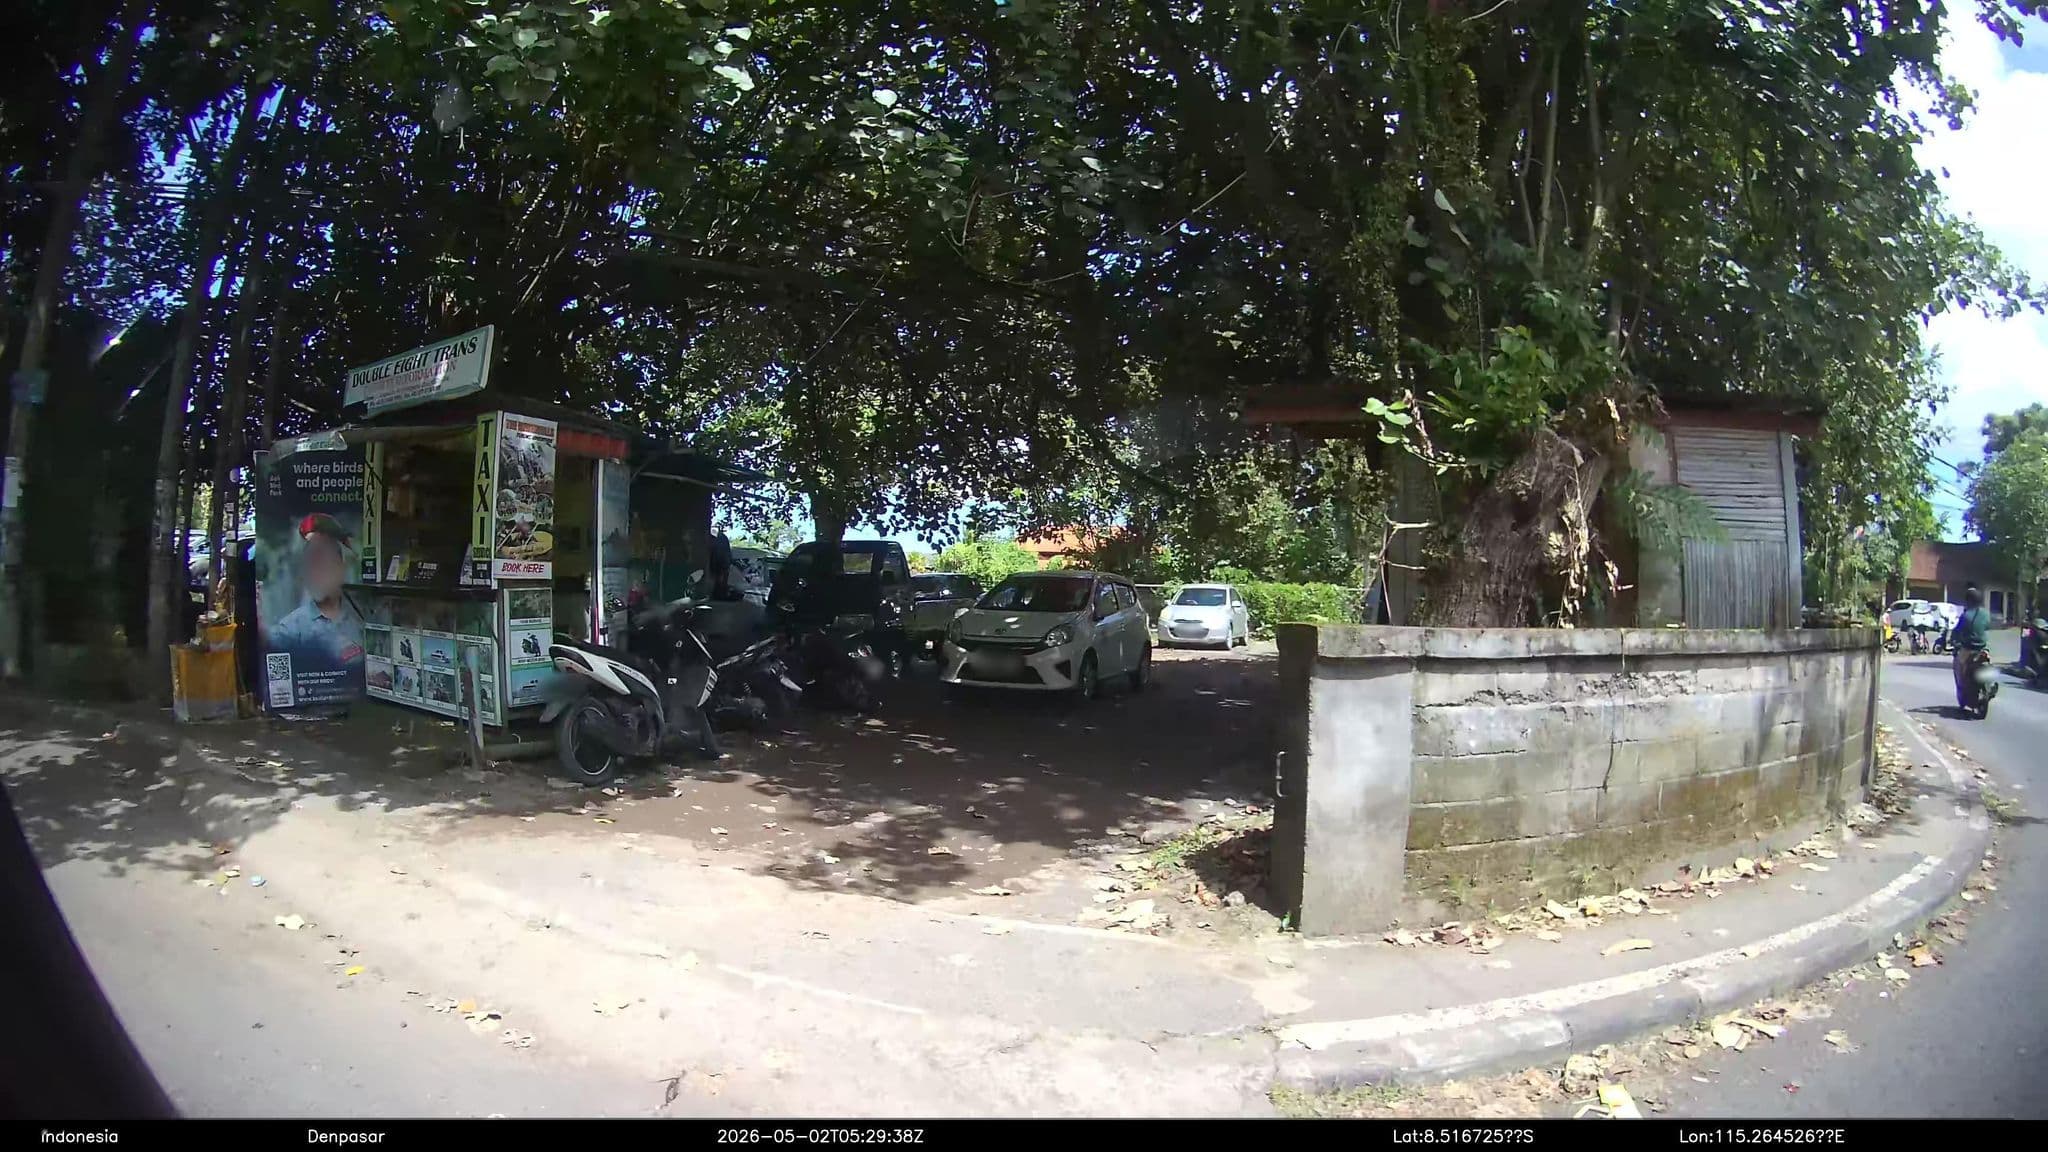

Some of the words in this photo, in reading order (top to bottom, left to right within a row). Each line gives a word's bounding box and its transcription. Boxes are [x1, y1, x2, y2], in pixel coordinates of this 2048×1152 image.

[352, 361, 393, 388] DOUBLE
[393, 351, 432, 375] EIGHT
[434, 336, 478, 363] TRANS
[293, 462, 331, 474] where
[332, 461, 364, 474] birds
[296, 476, 320, 488] and
[322, 476, 364, 492] people
[477, 418, 494, 546] TAXI
[311, 491, 363, 502] connect.
[502, 562, 522, 573] BOOK
[523, 563, 545, 573] HERE
